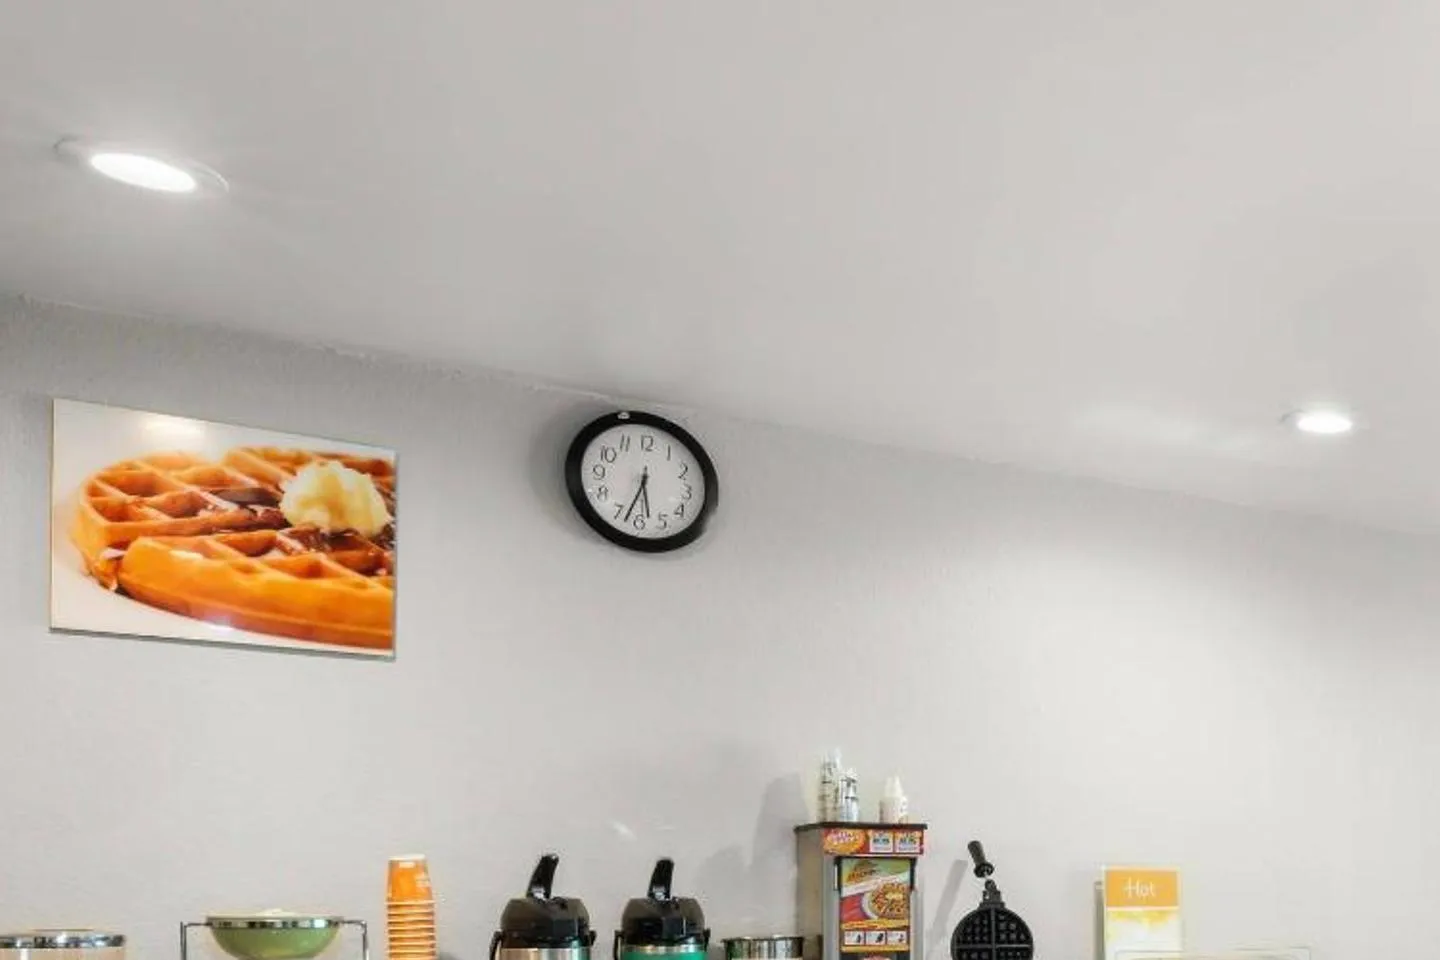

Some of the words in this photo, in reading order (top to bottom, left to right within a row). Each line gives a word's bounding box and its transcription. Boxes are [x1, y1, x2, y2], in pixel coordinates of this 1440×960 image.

[619, 434, 631, 452] 11
[640, 435, 654, 452] 12
[600, 445, 617, 463] 10
[592, 464, 606, 480] 9
[678, 463, 688, 481] 2
[596, 485, 609, 500] 8
[681, 484, 692, 500] 3
[613, 504, 624, 519] 7
[674, 504, 685, 519] 4
[633, 513, 646, 530] 6
[657, 514, 669, 530] 5
[1122, 876, 1156, 899] Hot
